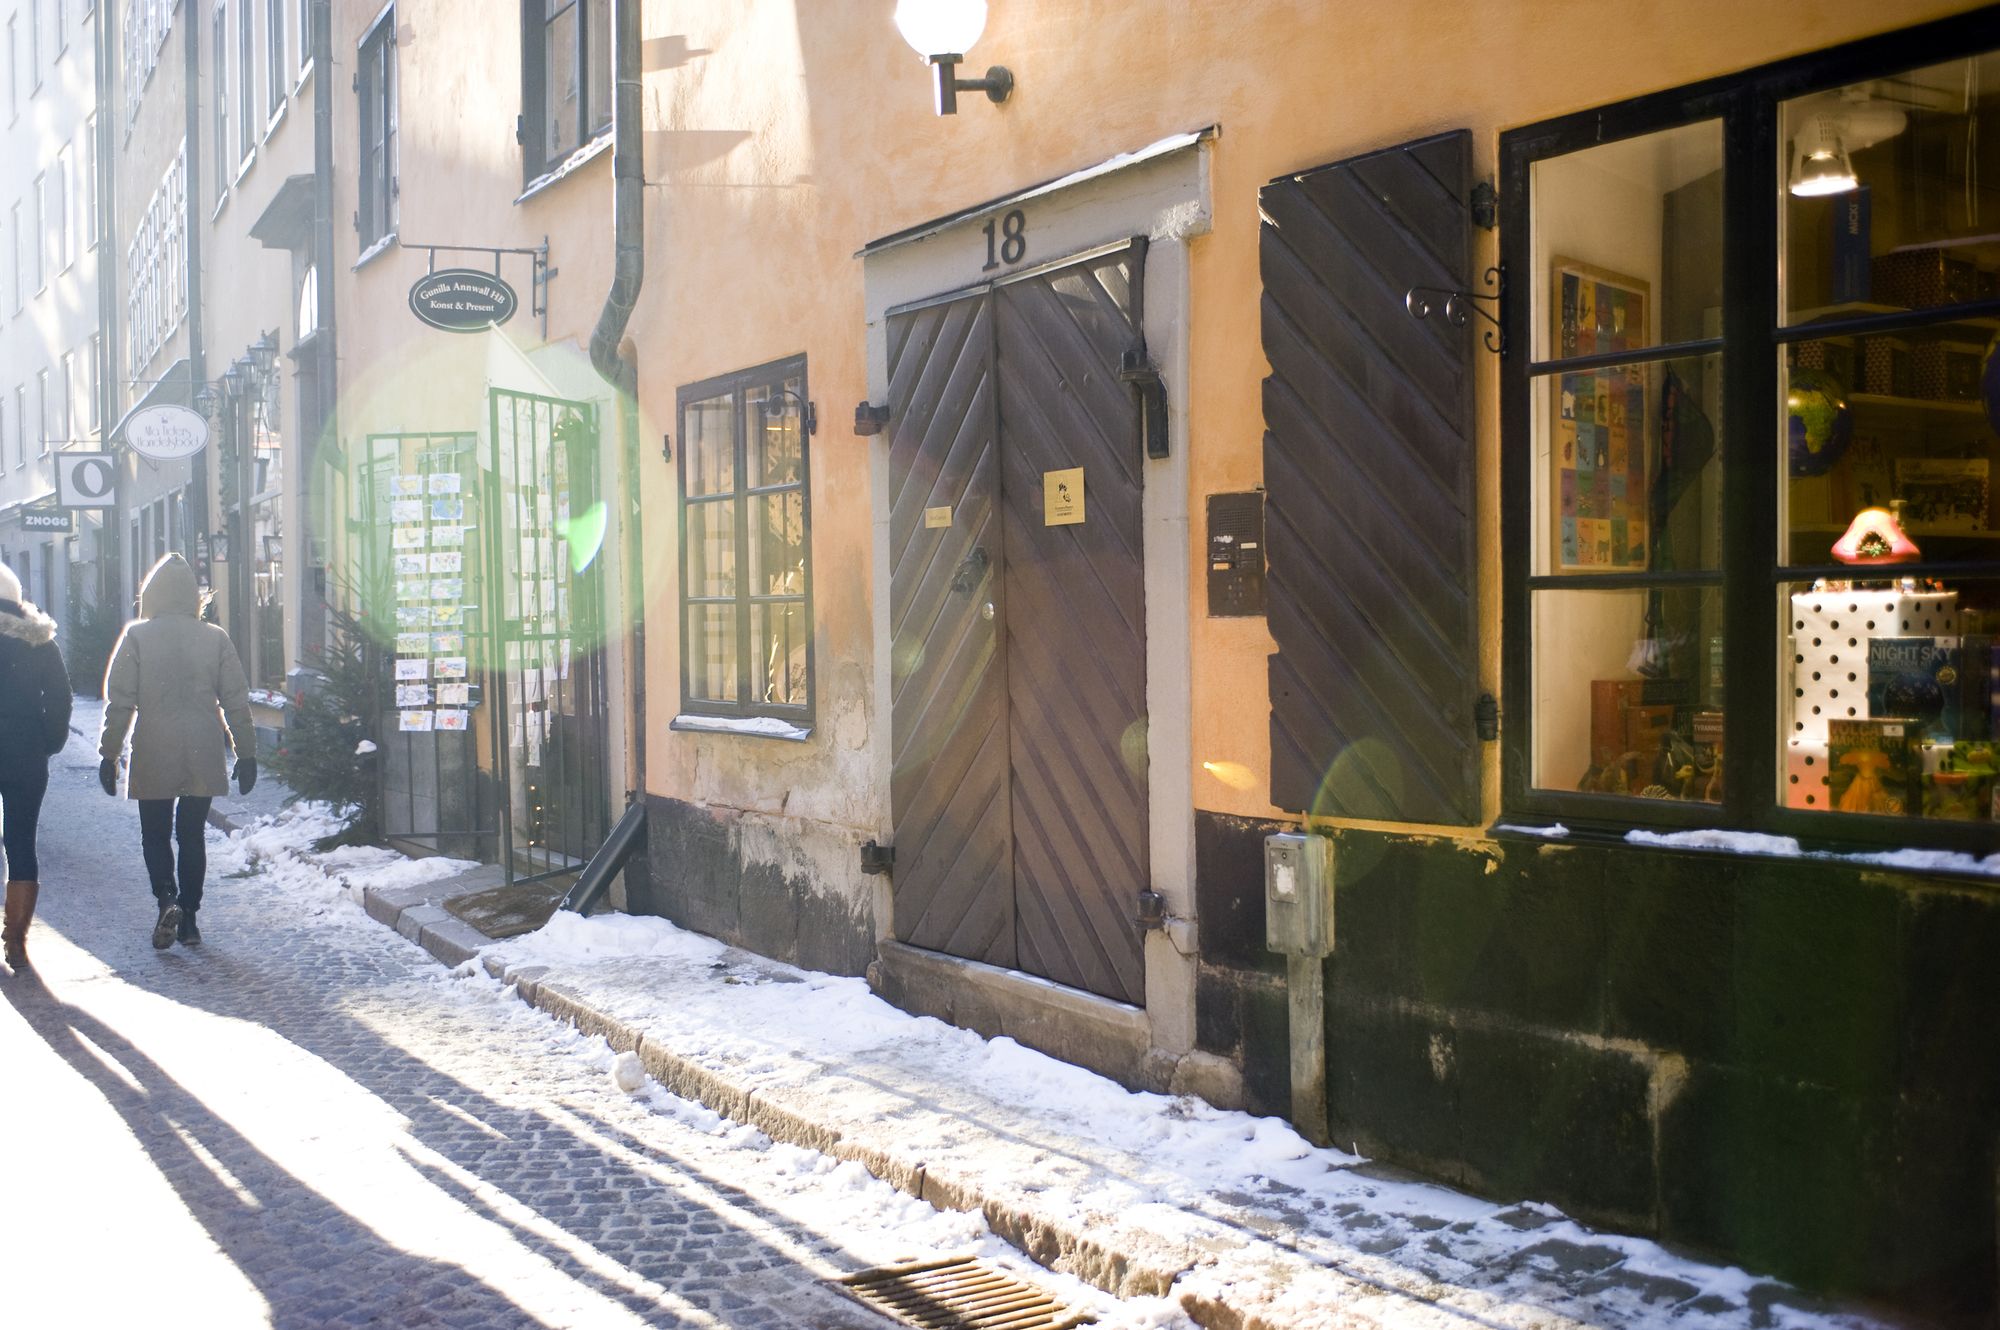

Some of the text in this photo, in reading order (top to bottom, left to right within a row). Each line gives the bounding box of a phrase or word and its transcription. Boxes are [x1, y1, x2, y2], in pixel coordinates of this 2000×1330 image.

[982, 209, 1026, 272] 18
[420, 283, 505, 304] Gunilla Annwall HB
[430, 300, 494, 312] Konst & Present
[25, 516, 69, 527] ZNOGG
[1871, 646, 1952, 661] NIGHT SKY
